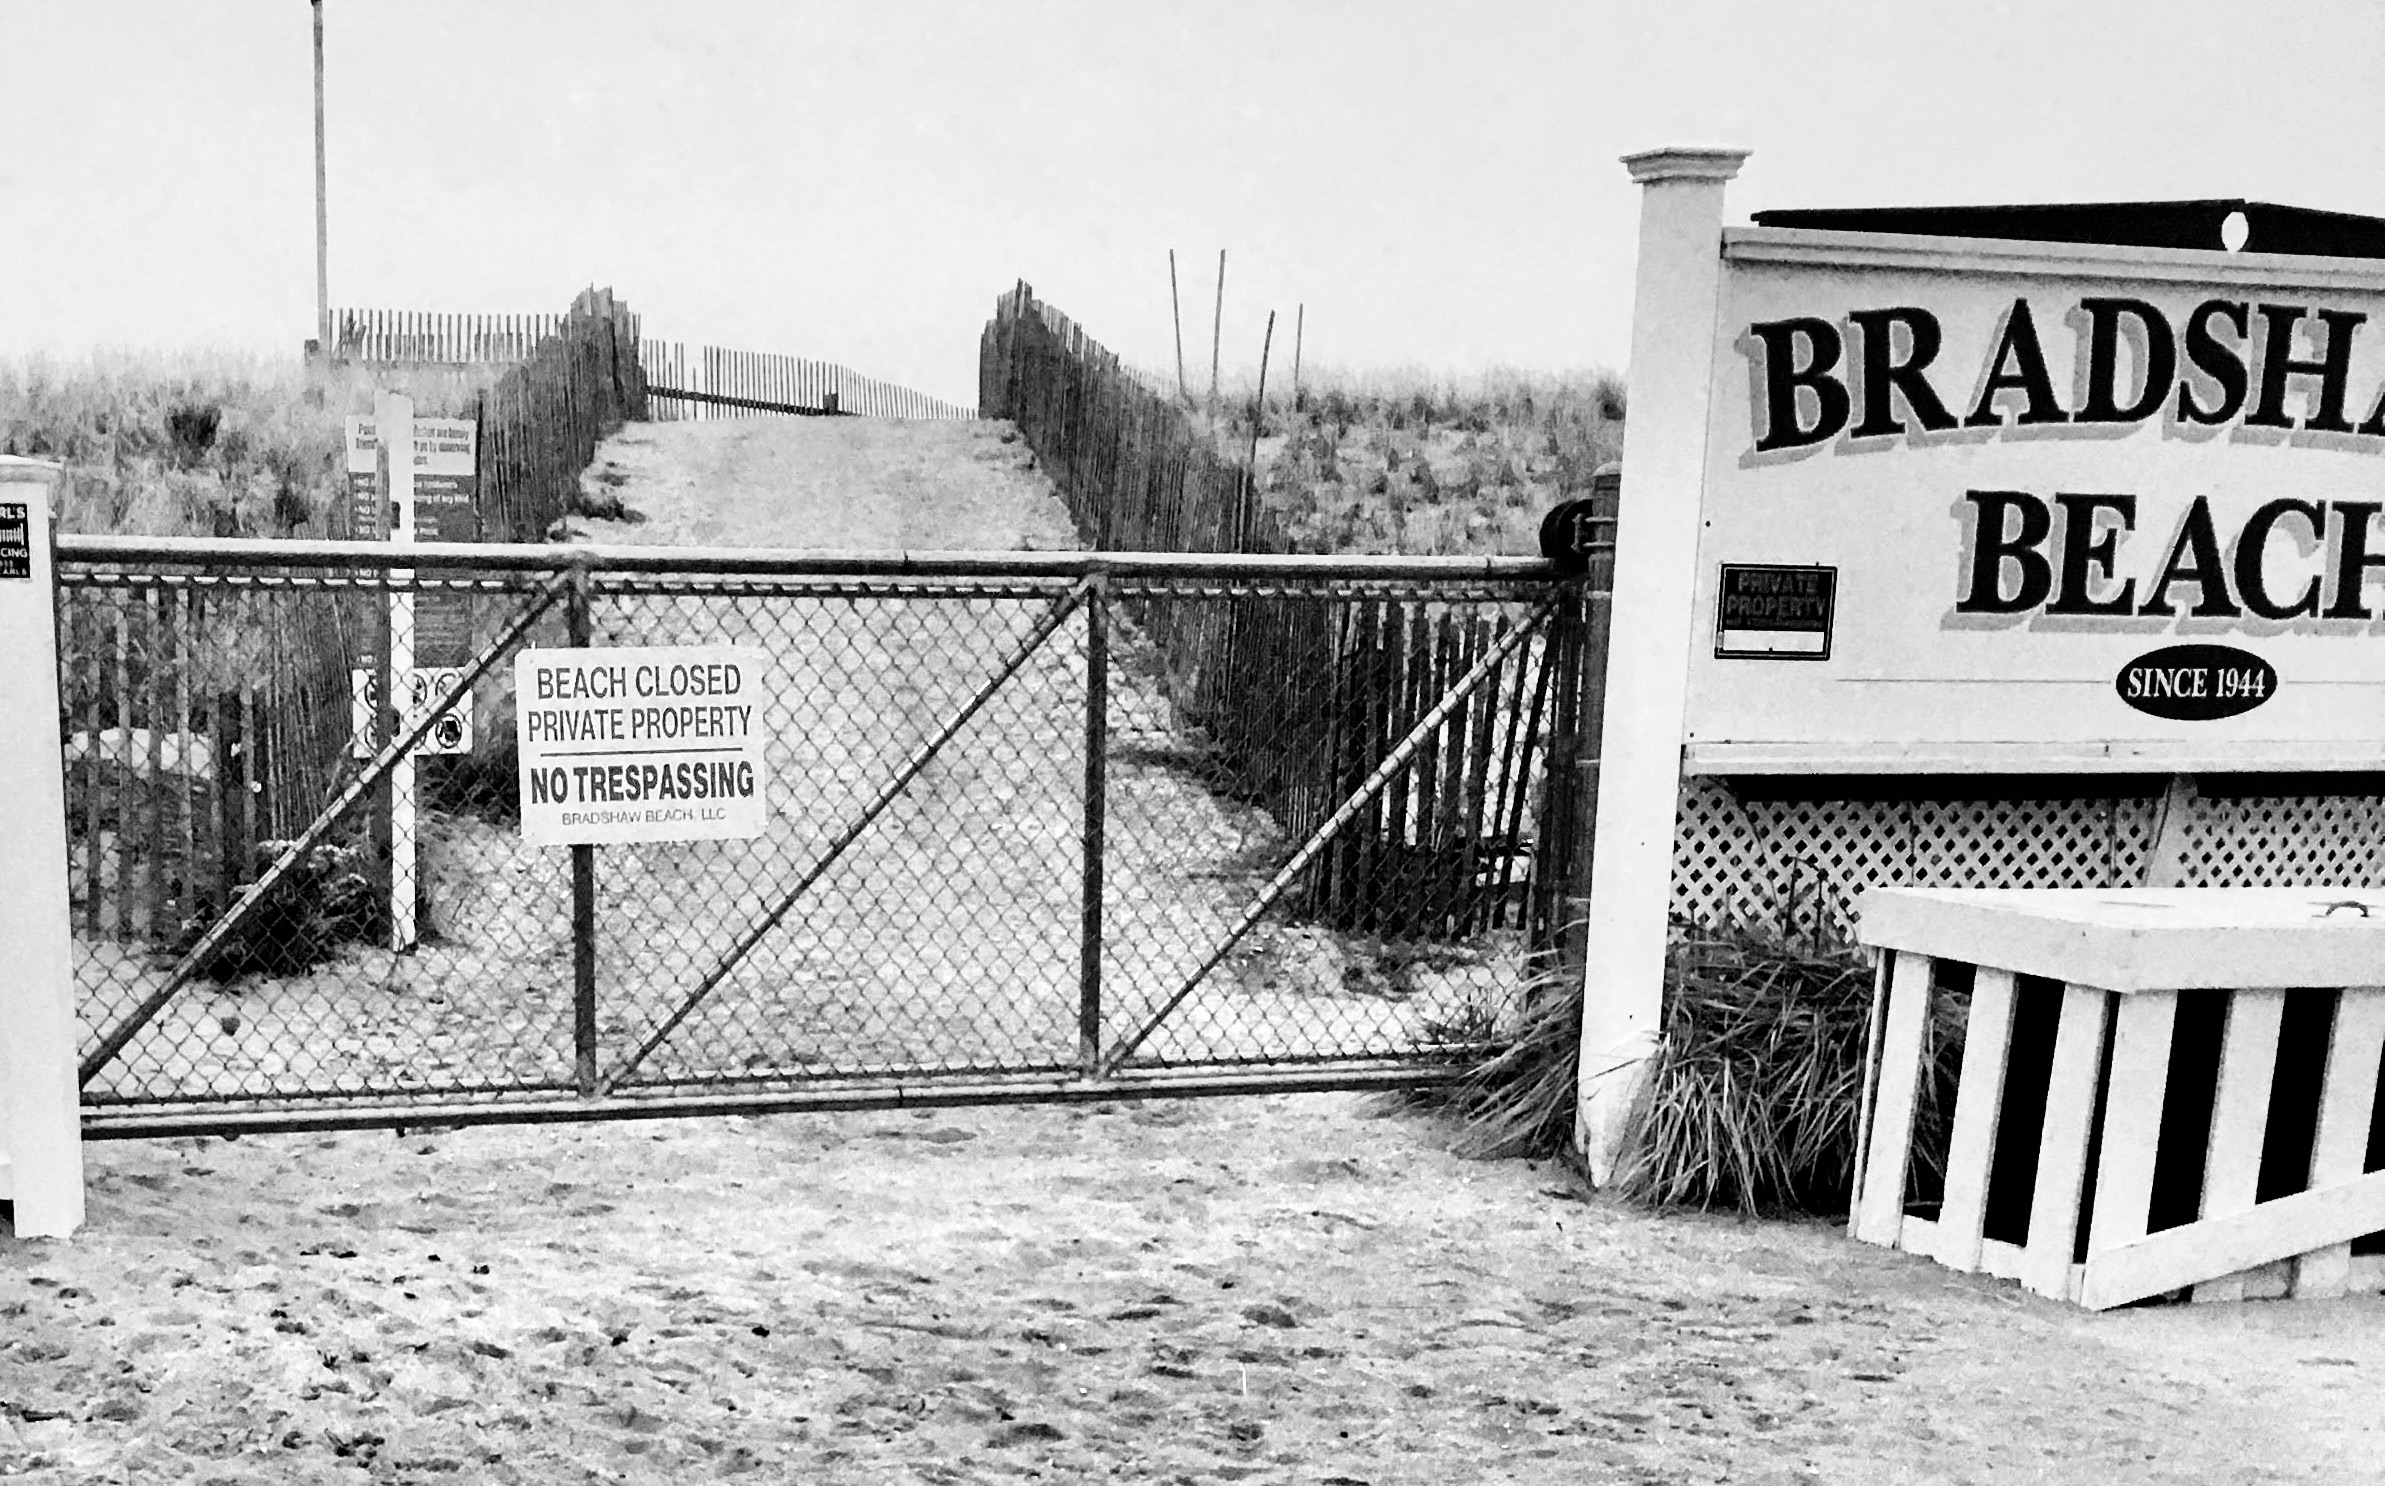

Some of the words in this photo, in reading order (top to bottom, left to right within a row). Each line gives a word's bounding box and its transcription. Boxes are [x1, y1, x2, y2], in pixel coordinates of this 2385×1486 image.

[1738, 571, 1819, 594] PRIVATE
[1726, 594, 1826, 617] PROPERTY
[537, 666, 627, 700] BEACH
[635, 664, 742, 698] CLOSED
[2127, 667, 2208, 698] SINCE
[2216, 667, 2266, 698] 1944
[528, 708, 625, 742] PRIVATE
[631, 705, 752, 740] PROPERTY
[530, 766, 569, 804] NO
[573, 760, 754, 803] TRESPASSING
[562, 810, 642, 826] BRADSHAW
[701, 807, 727, 821] LLC
